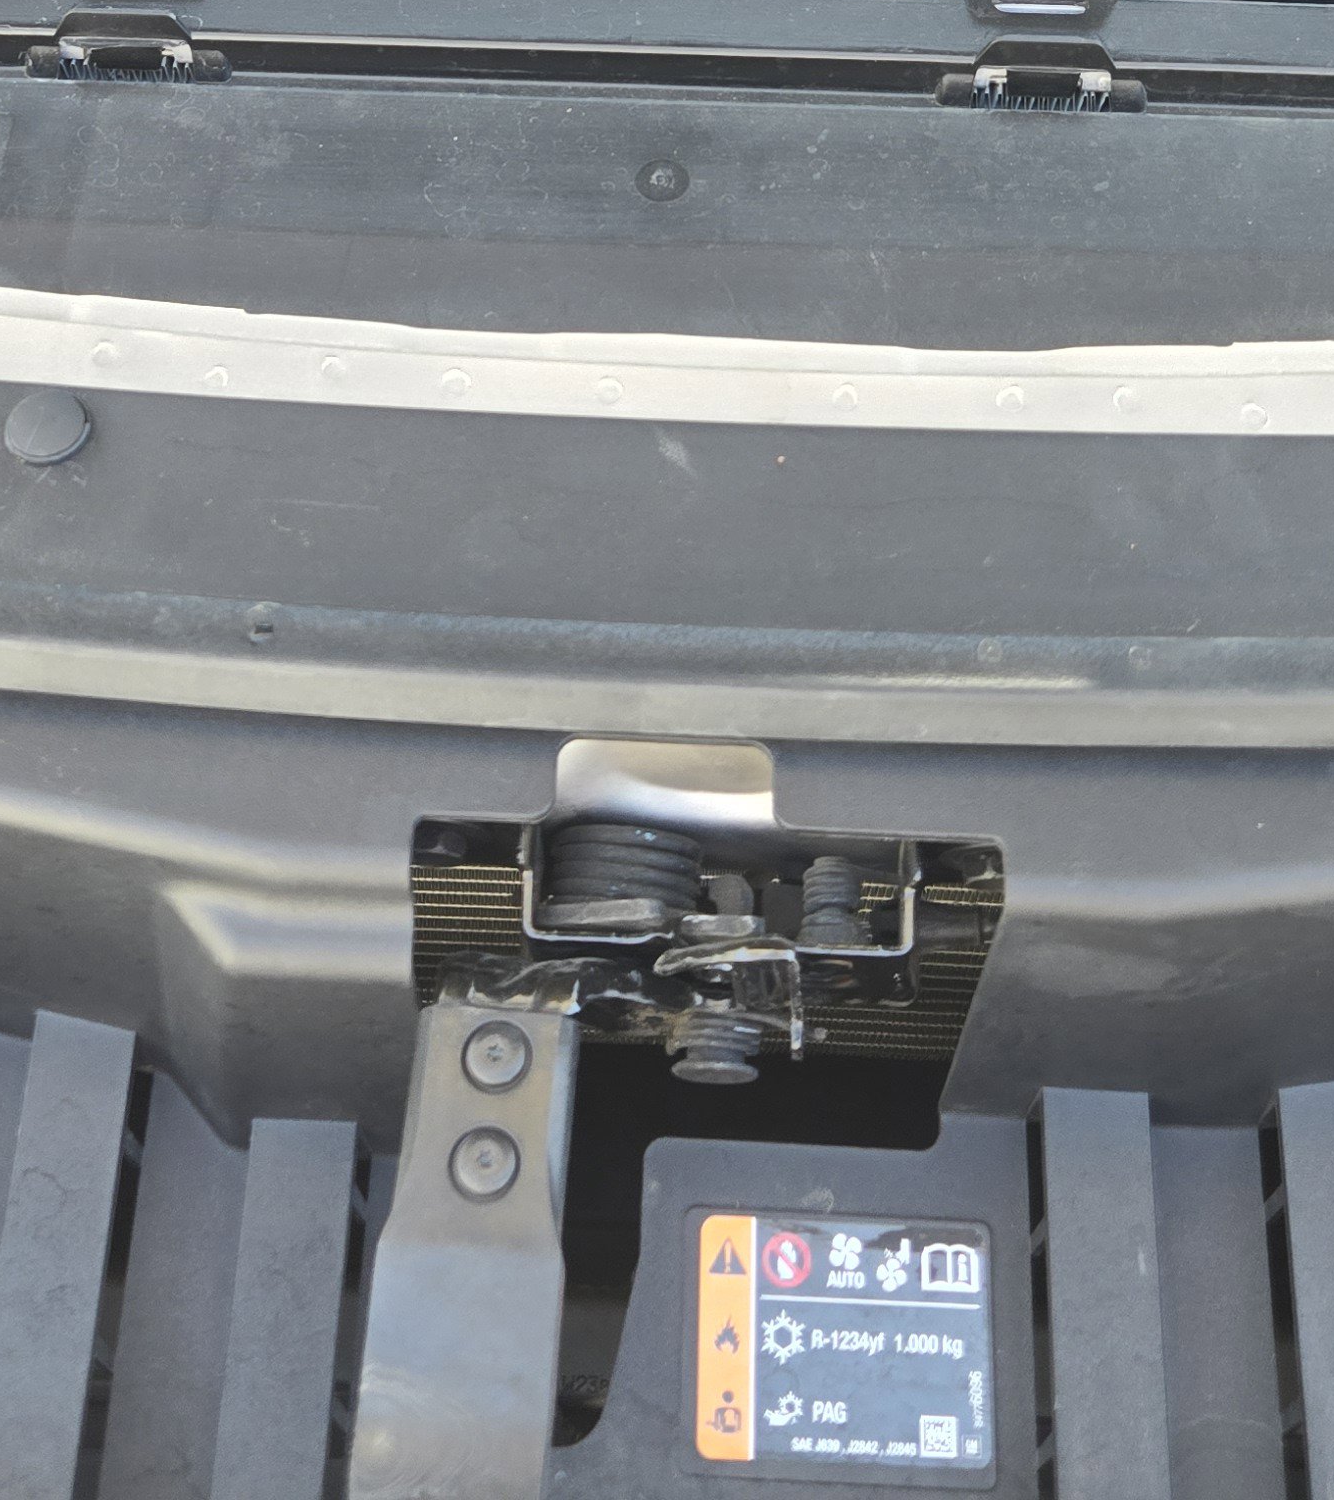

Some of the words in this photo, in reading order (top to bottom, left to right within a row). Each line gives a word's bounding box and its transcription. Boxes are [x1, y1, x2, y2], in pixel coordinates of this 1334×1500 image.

[826, 1270, 866, 1289] AUTO
[810, 1328, 886, 1356] R-1234yf
[894, 1333, 940, 1354] 1.000
[941, 1334, 964, 1359] kg
[811, 1400, 848, 1422] PAG
[790, 1436, 813, 1453] SAE
